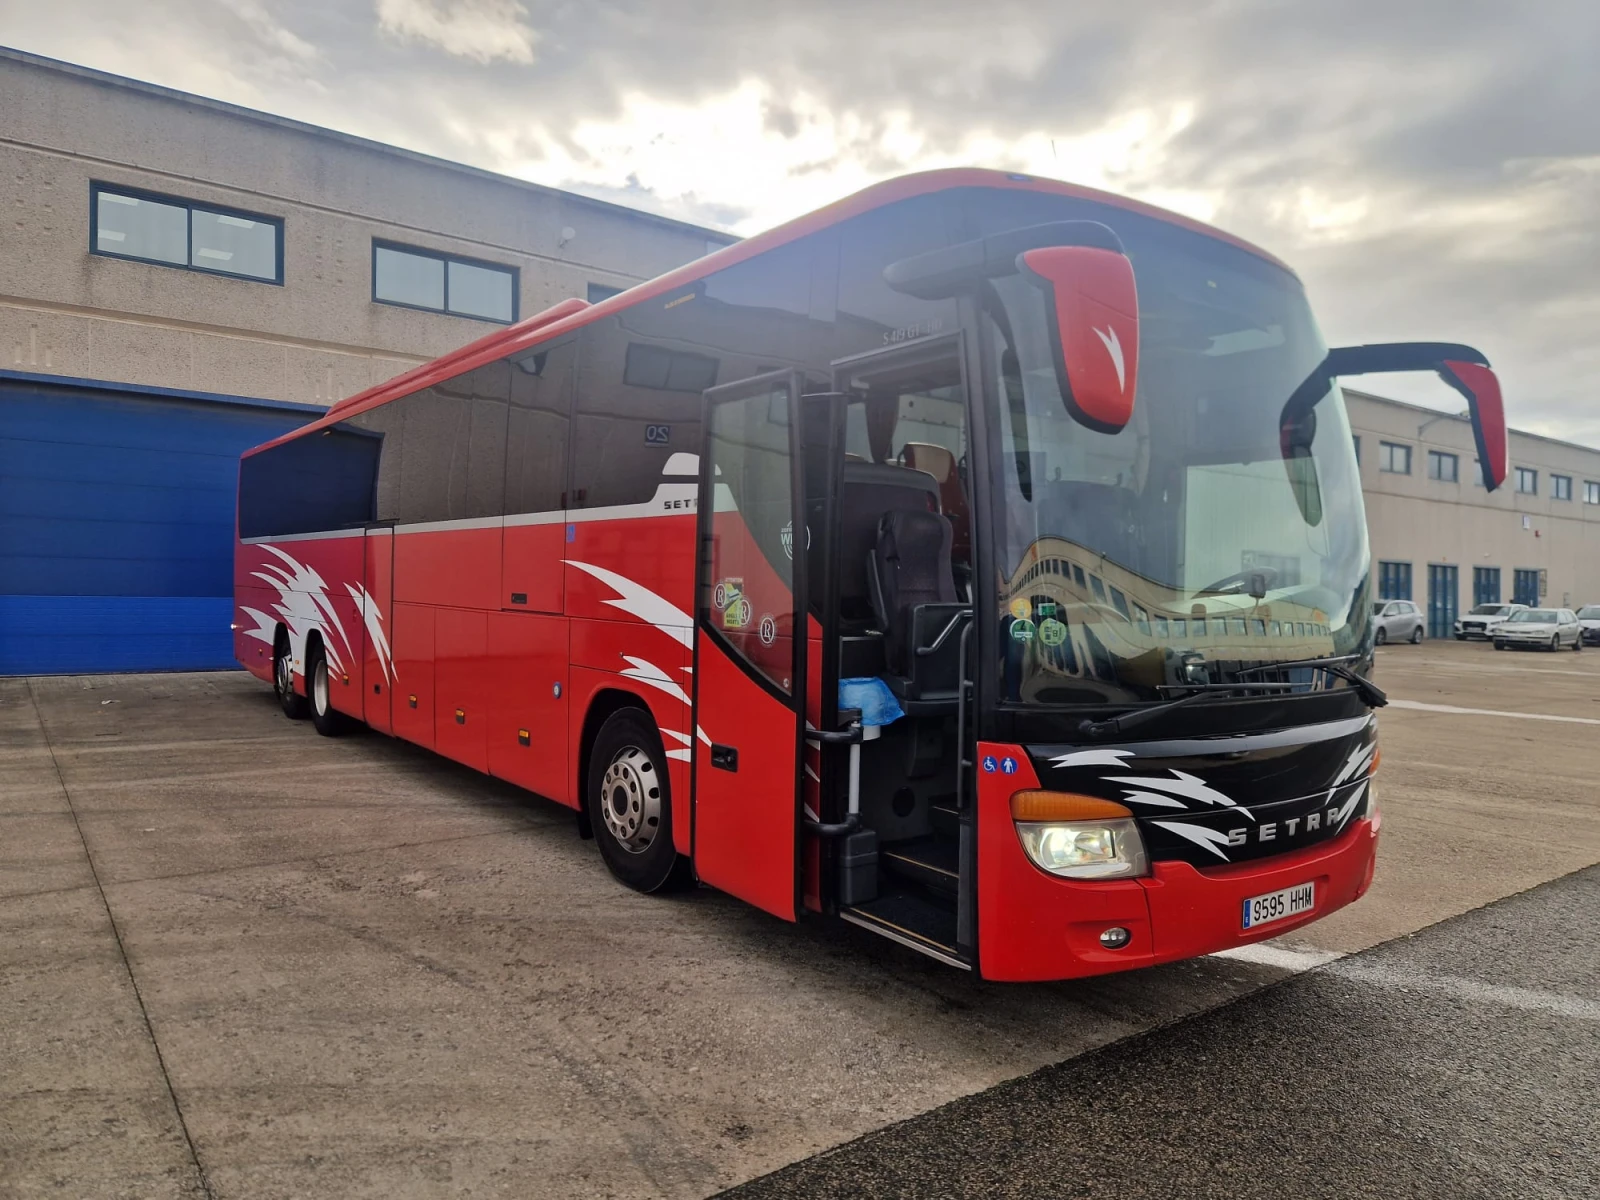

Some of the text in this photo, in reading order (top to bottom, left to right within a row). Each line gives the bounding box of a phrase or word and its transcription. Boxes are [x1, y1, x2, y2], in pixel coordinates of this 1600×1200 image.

[883, 331, 889, 346] S
[663, 499, 698, 510] SET
[1228, 807, 1340, 847] SETRA
[1253, 886, 1313, 922] 9595 HHM
